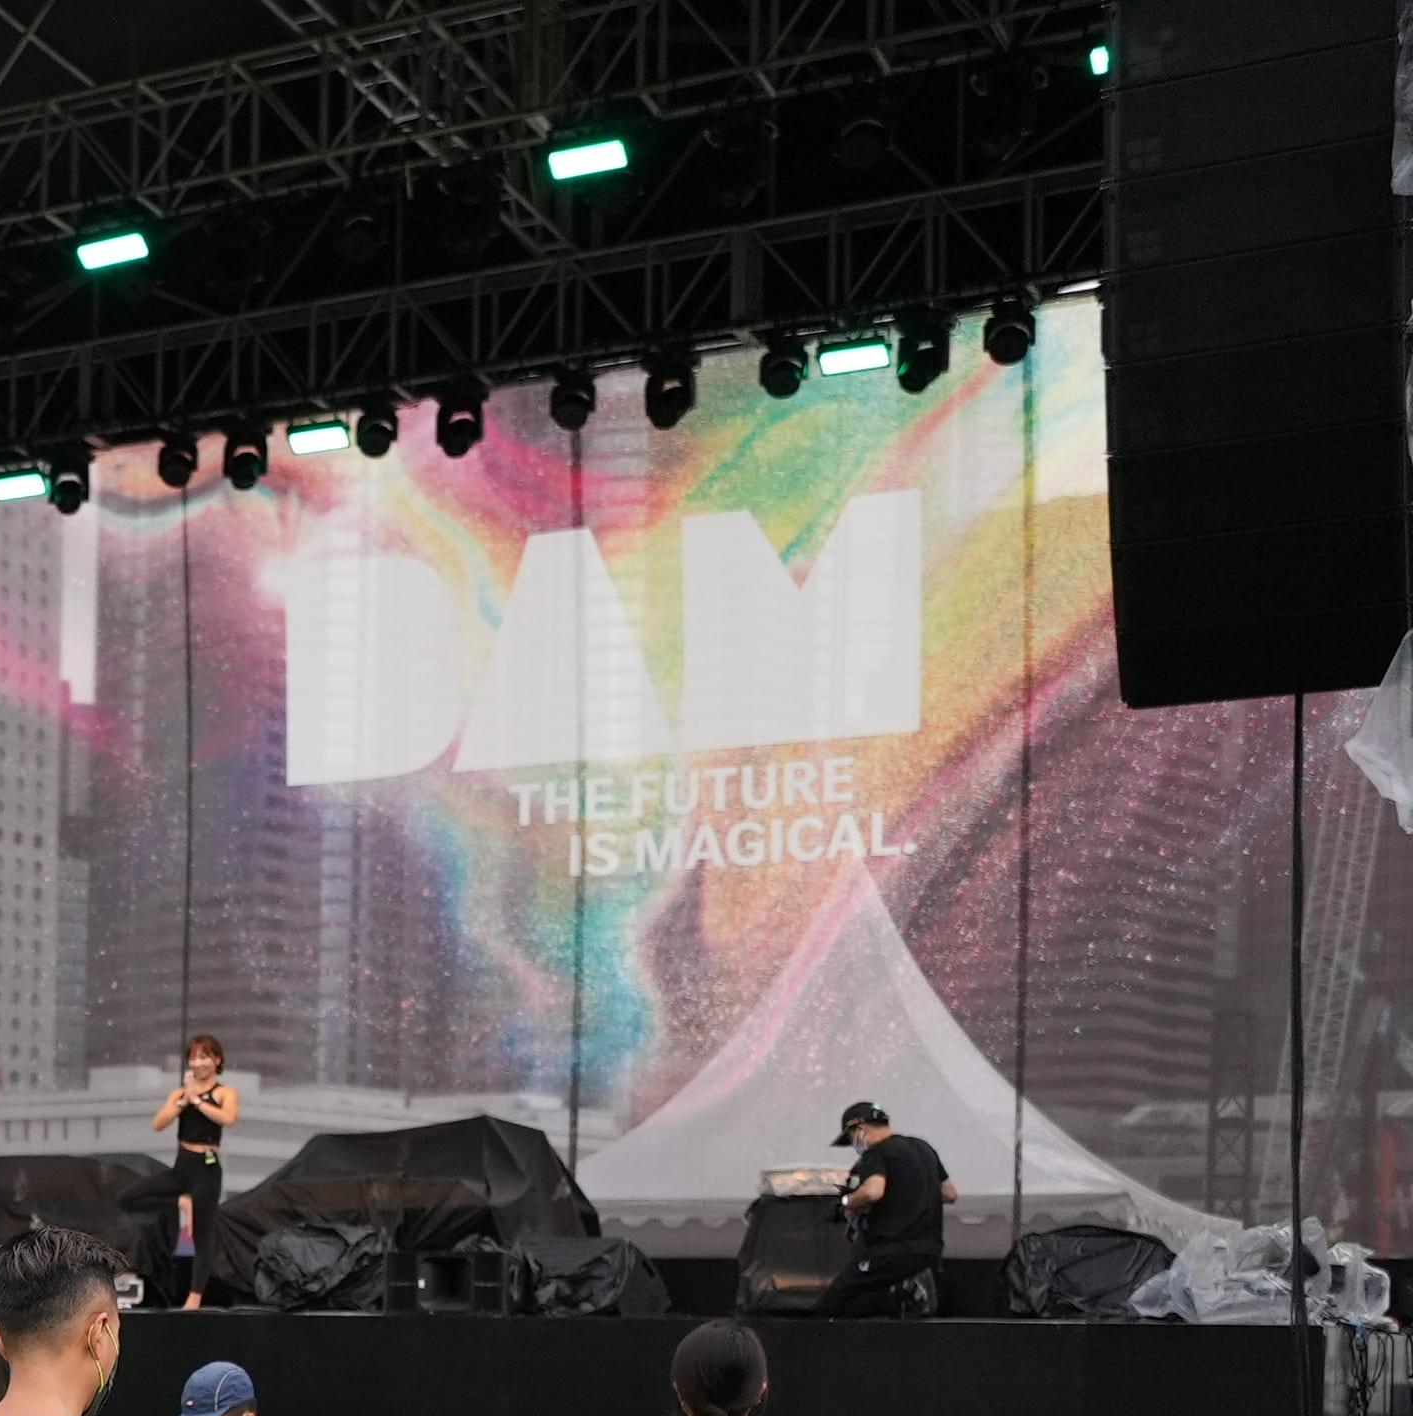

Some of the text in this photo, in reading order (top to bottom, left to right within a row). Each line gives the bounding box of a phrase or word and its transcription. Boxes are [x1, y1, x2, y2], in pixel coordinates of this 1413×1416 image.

[285, 489, 921, 786] DAM
[508, 757, 854, 826] THE FUTURE
[570, 812, 917, 877] IS MAGICAL.
